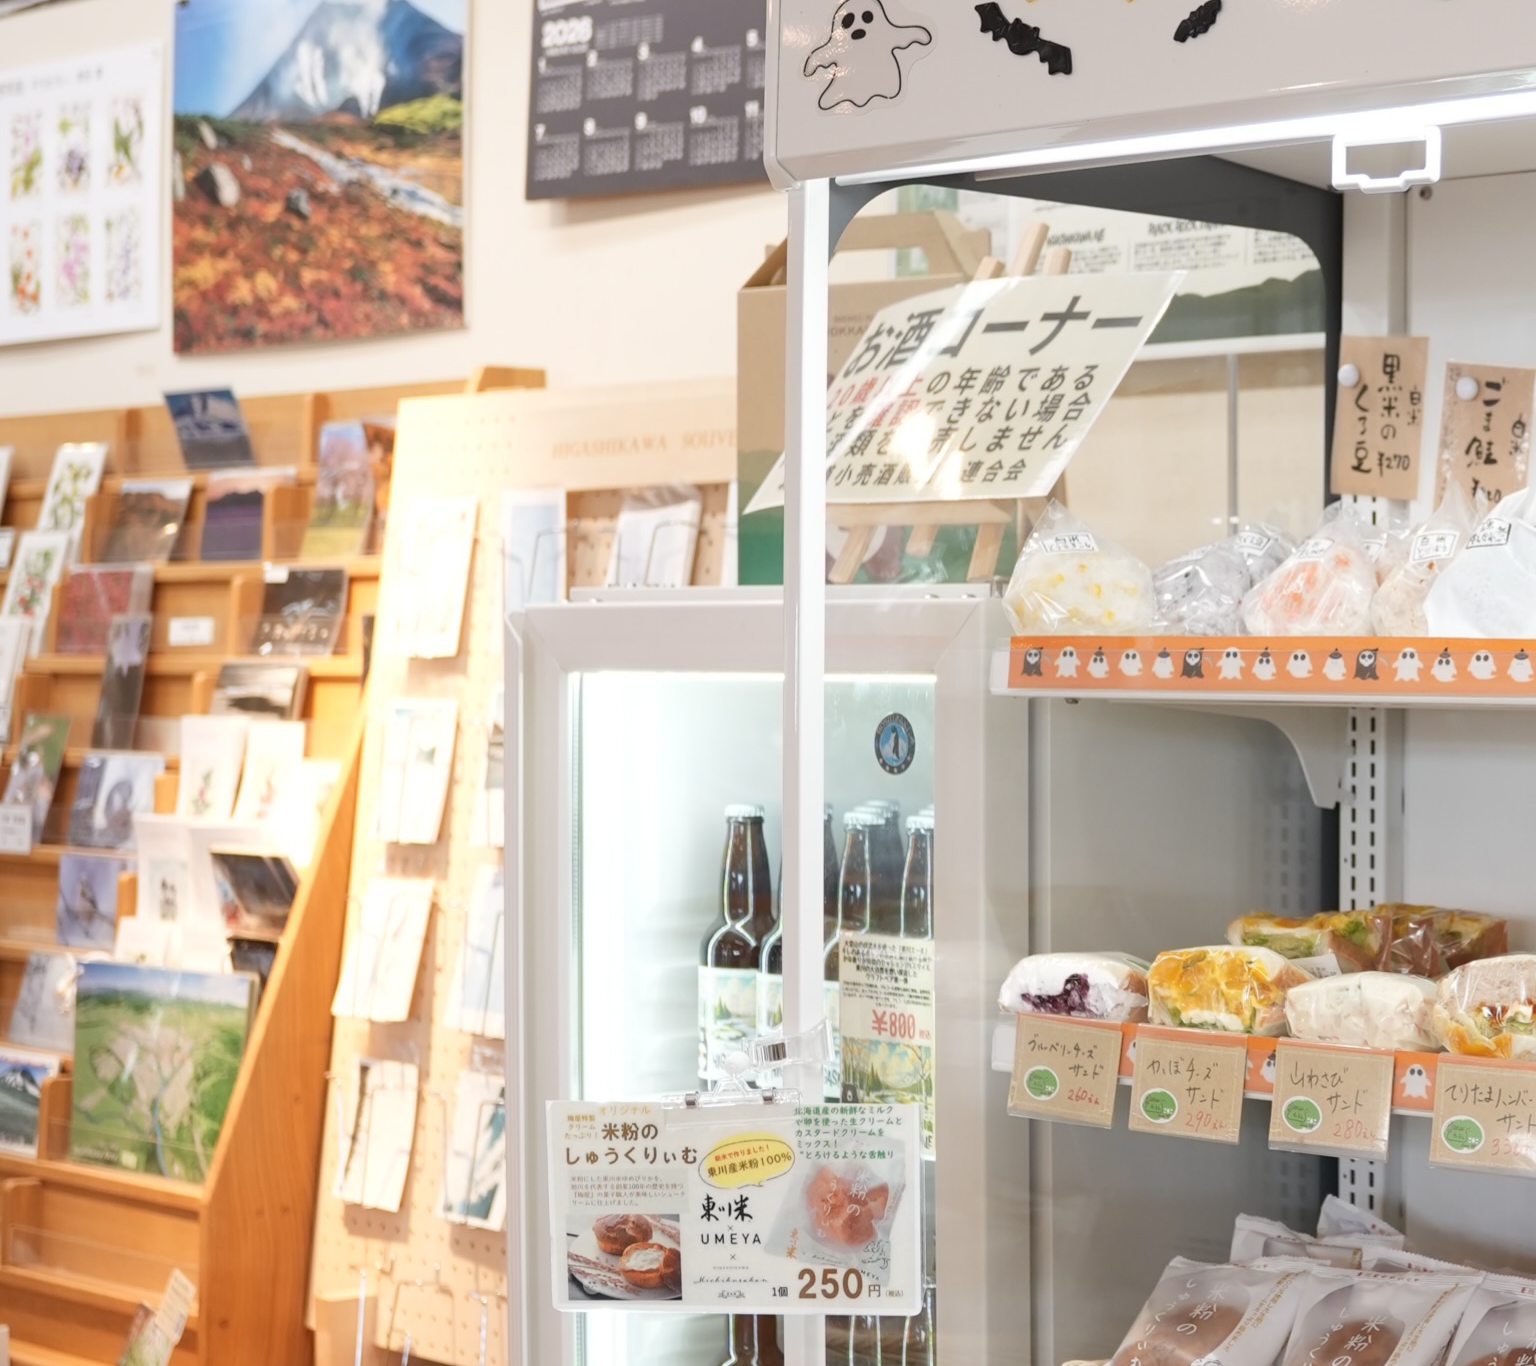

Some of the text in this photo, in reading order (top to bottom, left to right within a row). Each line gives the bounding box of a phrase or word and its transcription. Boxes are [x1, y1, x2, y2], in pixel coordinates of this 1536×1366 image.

[843, 295, 1143, 379] お酒コーナー
[1377, 353, 1403, 440] 黒米の
[552, 433, 668, 459] HIGASHIKAWA
[1377, 452, 1410, 477] ¥270
[872, 1009, 915, 1039] ¥800
[1068, 1063, 1104, 1077] サンド
[1290, 1061, 1349, 1089] 山わさび
[1067, 1089, 1100, 1105] 260えん
[1186, 1086, 1225, 1109] サンド
[1326, 1089, 1368, 1115] サンド
[599, 1106, 650, 1115] オリジナル
[794, 1106, 893, 1116] 北海道産の新鮮なミルク
[795, 1117, 902, 1126] や卵を使った生クリームと
[602, 1123, 658, 1141] 米粉の
[796, 1128, 884, 1137] カスタードクリームを
[1185, 1111, 1228, 1133] 290えん
[1332, 1119, 1378, 1140] 280えん
[566, 1147, 697, 1165] しゅうくりぃむ
[707, 1152, 792, 1178] 東川産米粉100%
[701, 1234, 761, 1245] UMEYA
[1176, 1286, 1226, 1335] 米粉の
